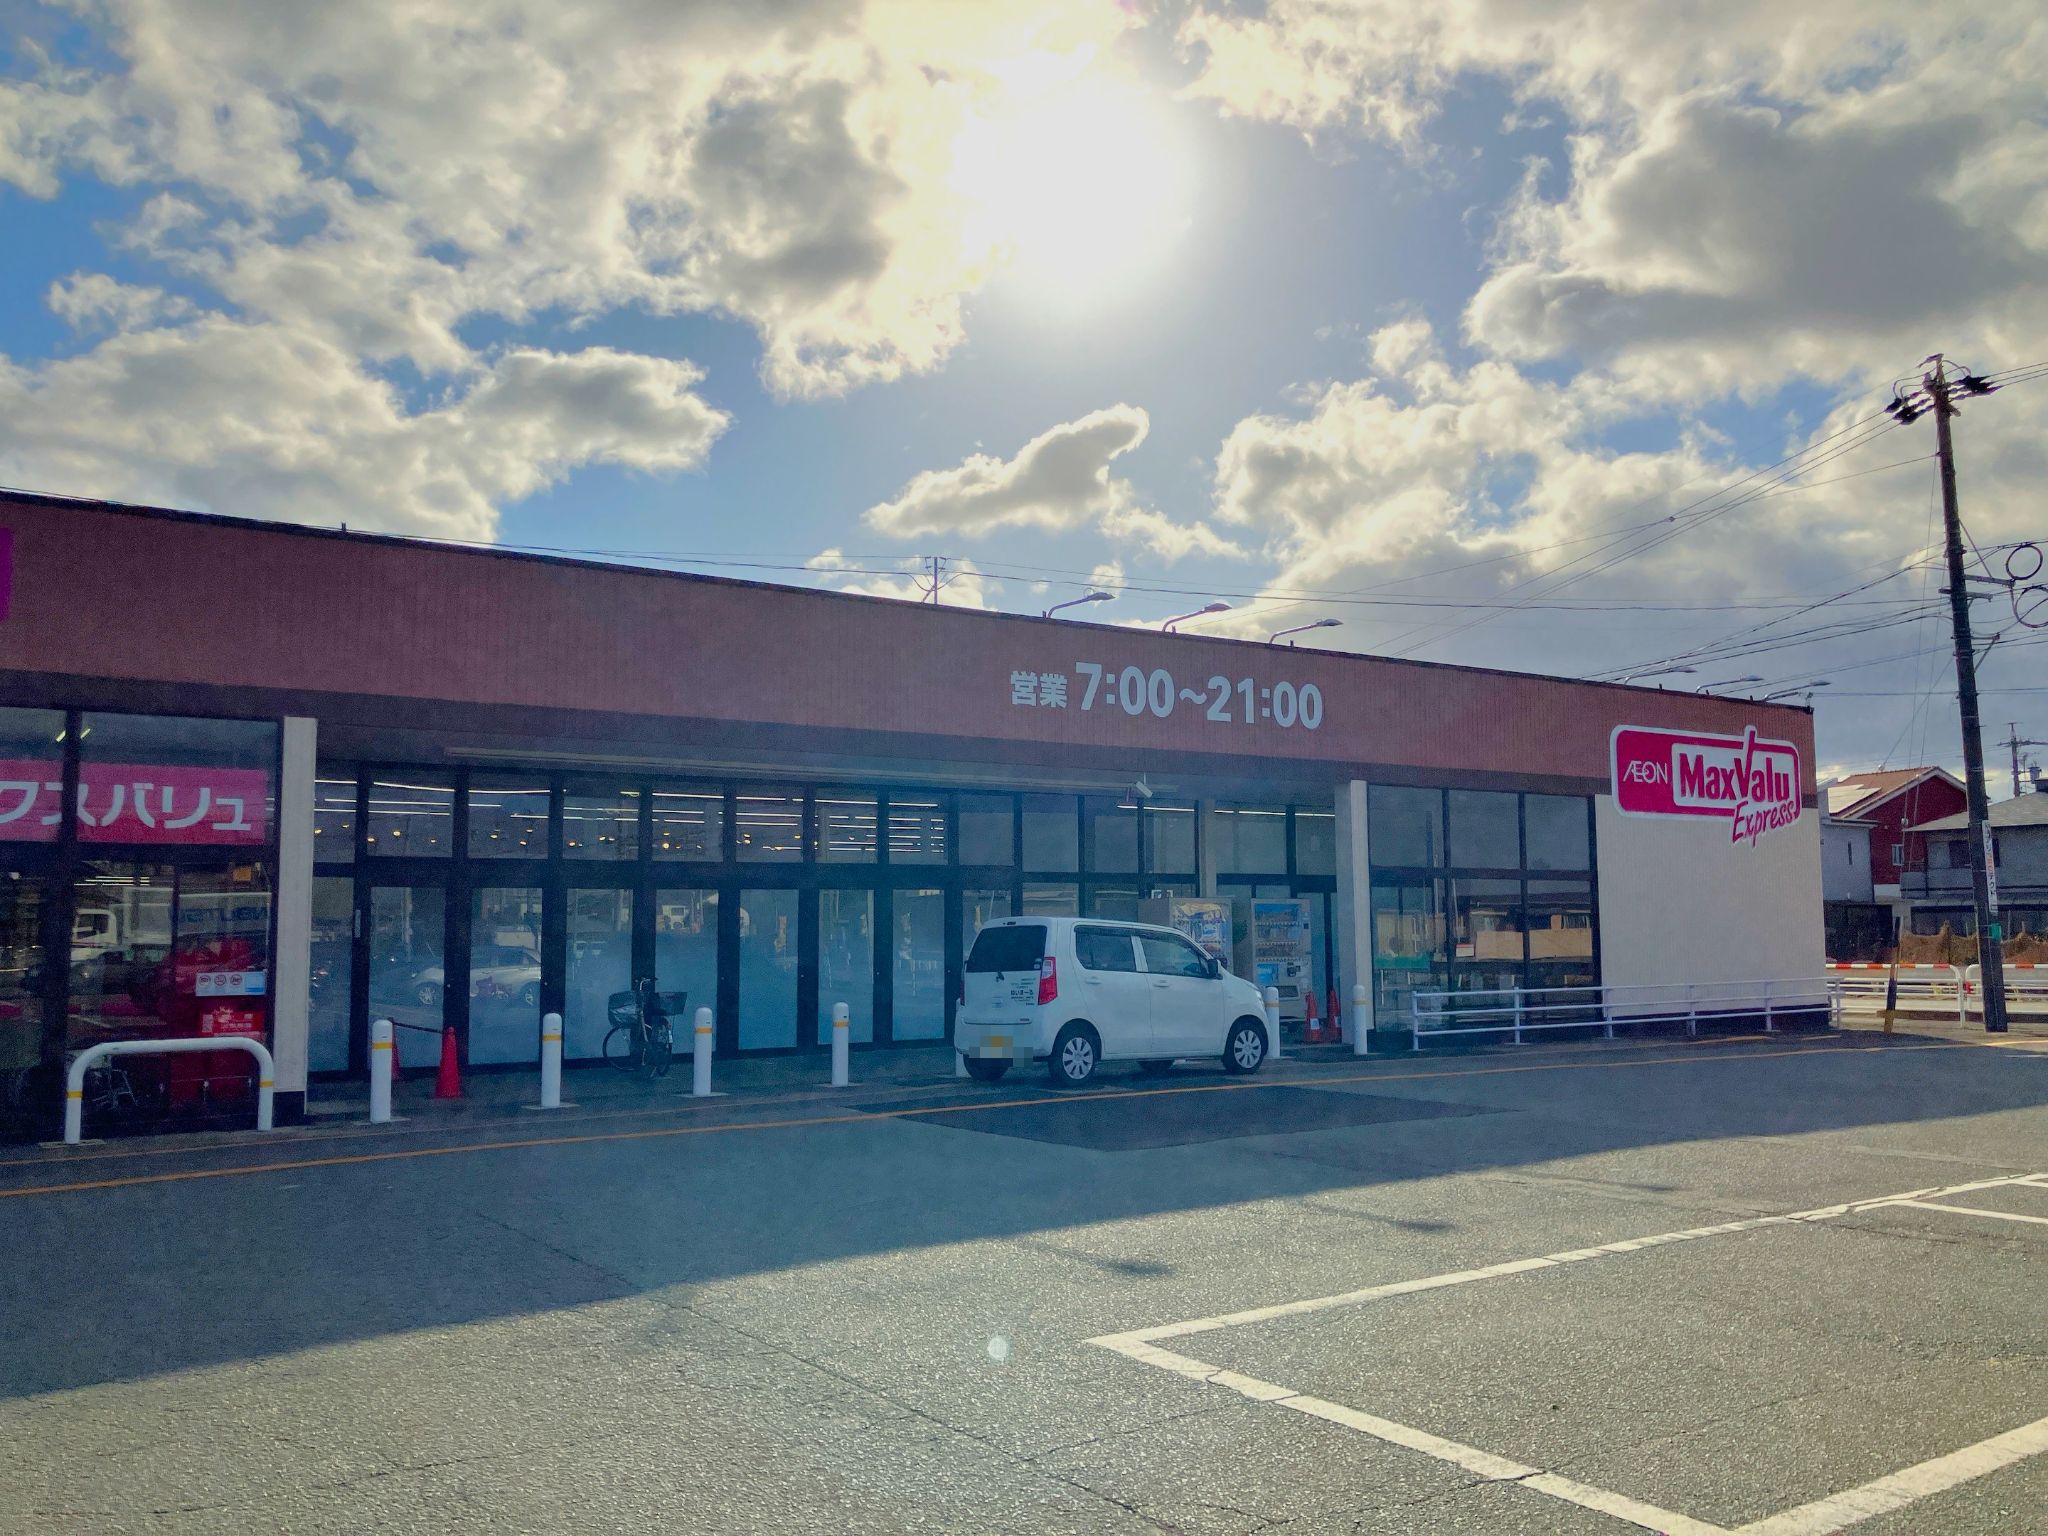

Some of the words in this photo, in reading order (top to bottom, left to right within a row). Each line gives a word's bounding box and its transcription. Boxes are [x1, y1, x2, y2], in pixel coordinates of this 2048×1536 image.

[1010, 671, 1068, 709] 営業
[1679, 730, 1790, 803] MaxValu
[1732, 800, 1797, 848] Express
